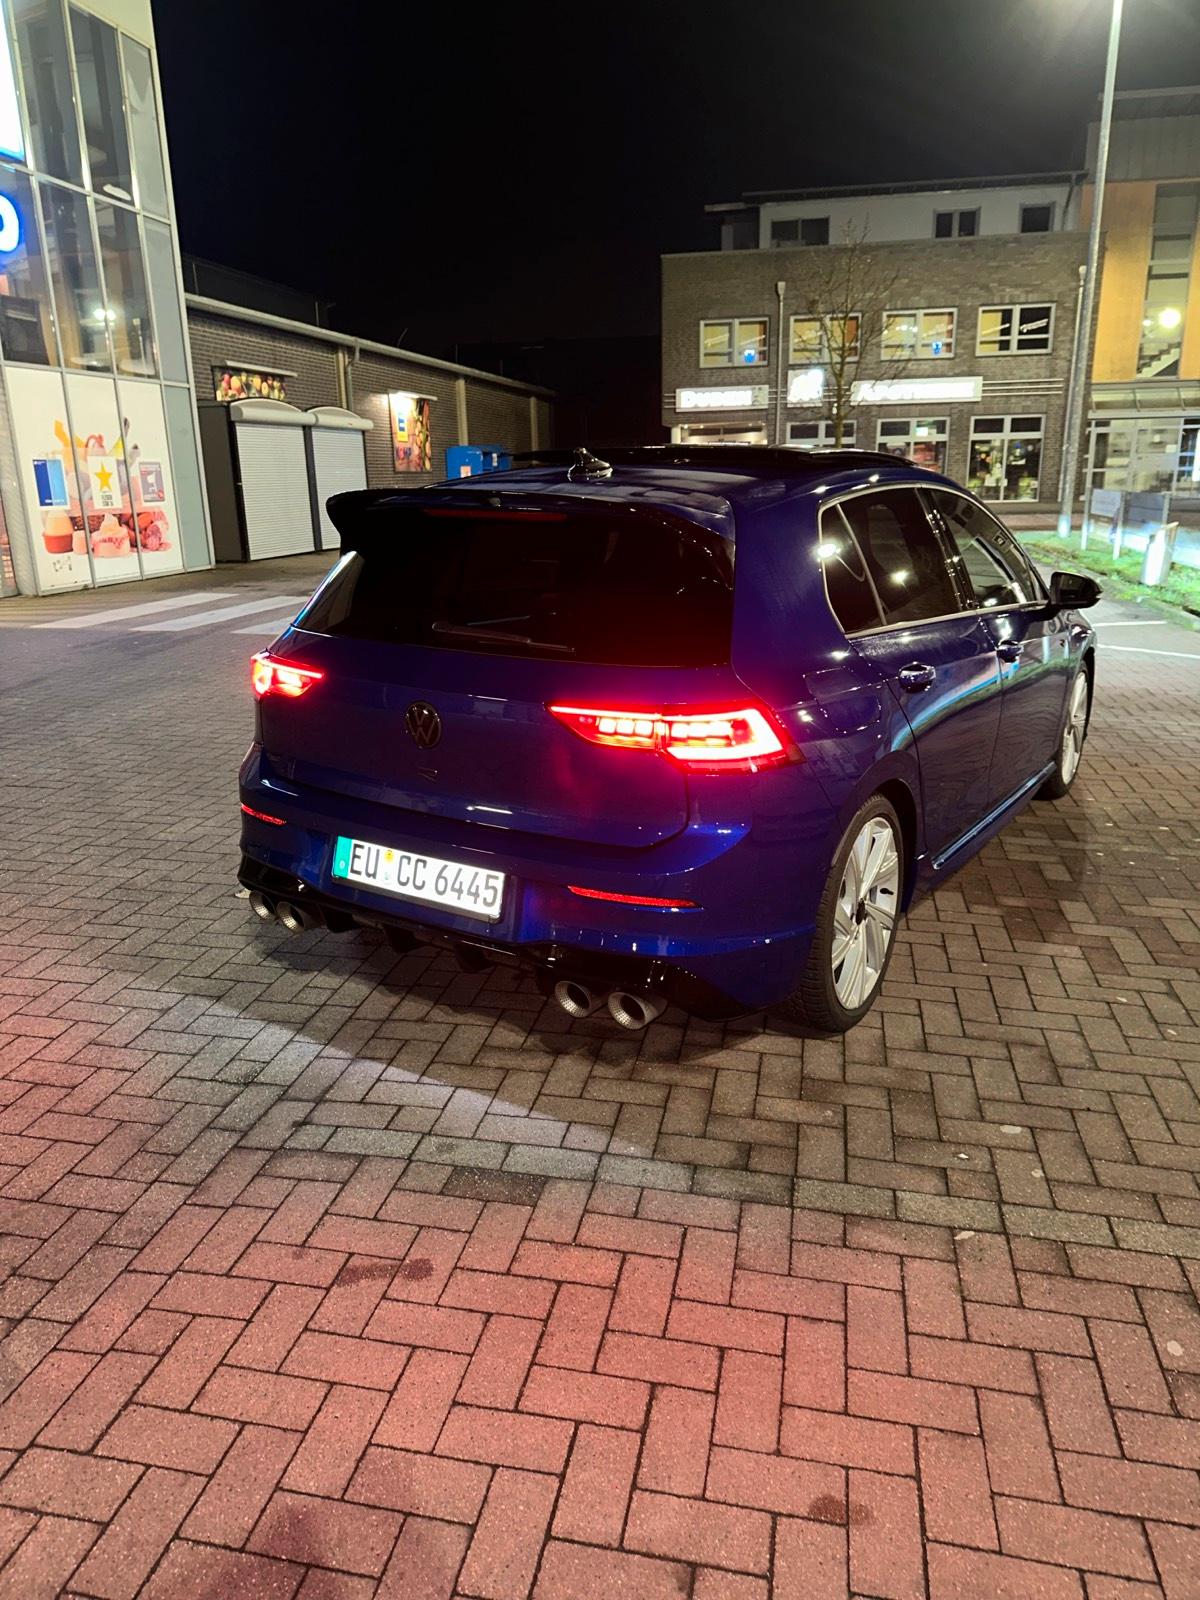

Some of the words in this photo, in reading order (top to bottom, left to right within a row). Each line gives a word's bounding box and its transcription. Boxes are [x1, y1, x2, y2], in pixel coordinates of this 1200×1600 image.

[406, 702, 441, 747] VW
[349, 843, 381, 880] EU
[397, 855, 428, 891] CC
[434, 864, 500, 908] 6445
